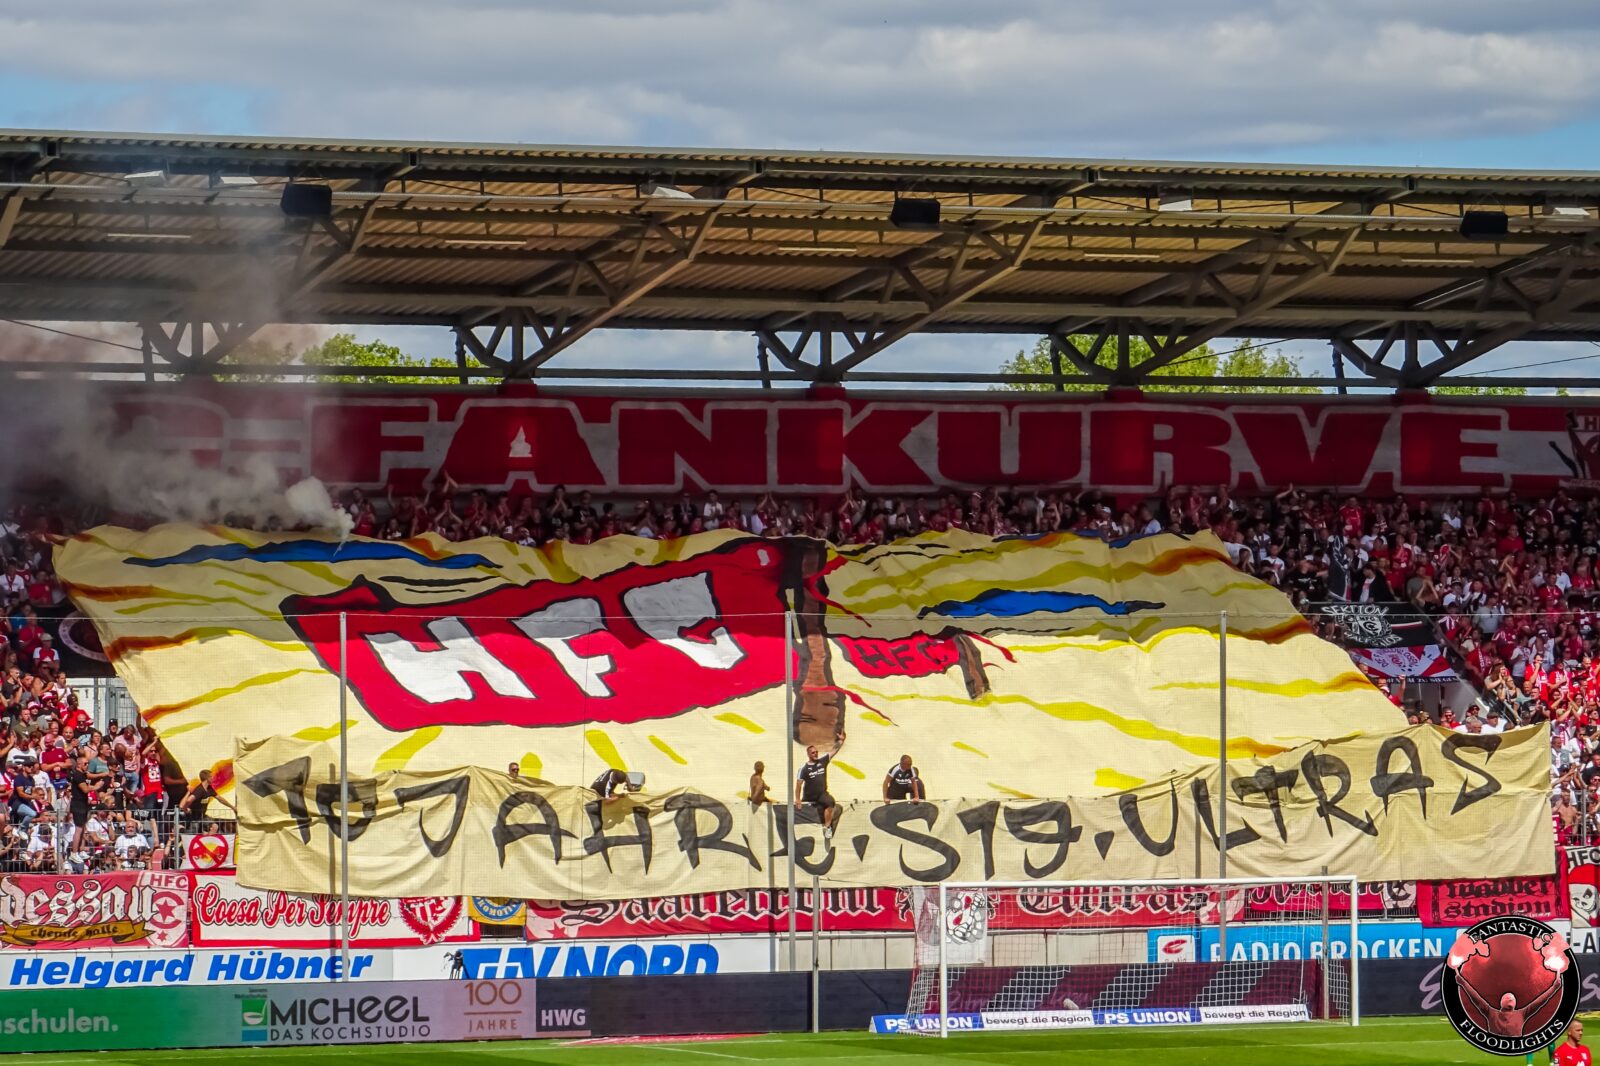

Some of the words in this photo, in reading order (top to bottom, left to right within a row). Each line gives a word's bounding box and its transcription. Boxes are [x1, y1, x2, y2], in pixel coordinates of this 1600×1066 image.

[305, 397, 1508, 497] FANKURVE
[364, 572, 747, 704] HFC
[853, 640, 950, 670] HFC
[150, 873, 188, 888] HFC
[264, 889, 307, 927] Per
[9, 954, 195, 989] Helgard
[207, 950, 374, 981] Hübner
[464, 980, 522, 1006] 100
[468, 1018, 518, 1032] JAHRE
[540, 1008, 586, 1027] HWG
[884, 1018, 909, 1030] PS
[915, 1016, 974, 1030] UNON
[985, 1016, 1028, 1025] bewegt
[1031, 1015, 1048, 1024] die
[1051, 1014, 1091, 1025] Region
[1104, 1013, 1130, 1025] PS
[1133, 1010, 1191, 1024] UNION
[1204, 1010, 1246, 1019] bewegt
[1249, 1009, 1265, 1018] die
[1268, 1007, 1306, 1018] Region
[270, 1028, 304, 1041] DAS
[311, 1024, 431, 1040] KOCHSTUDIO
